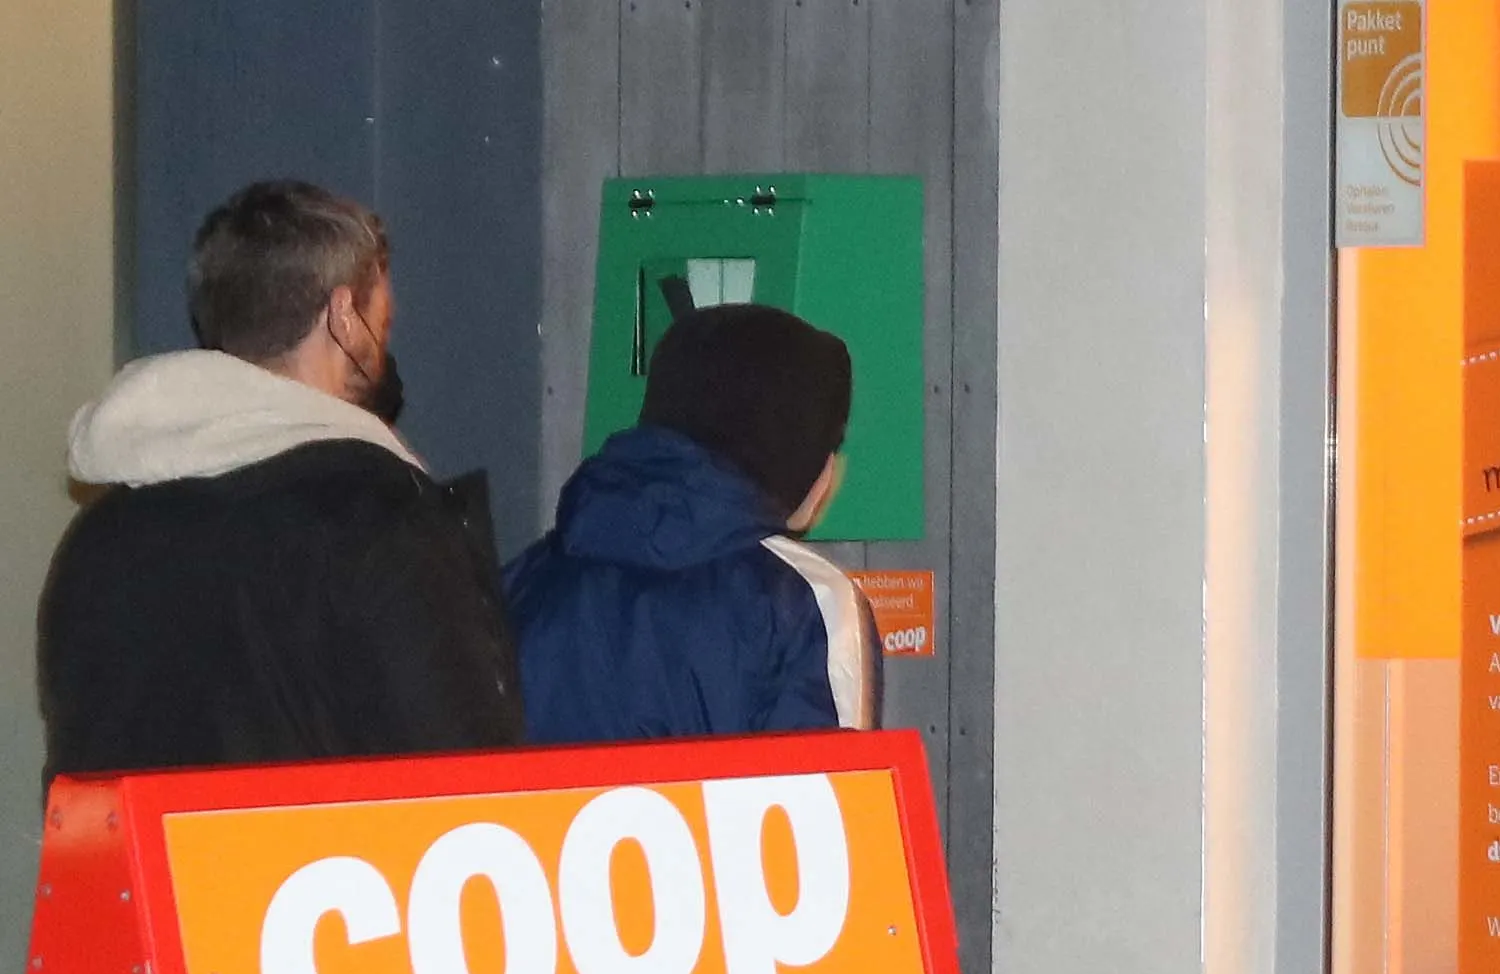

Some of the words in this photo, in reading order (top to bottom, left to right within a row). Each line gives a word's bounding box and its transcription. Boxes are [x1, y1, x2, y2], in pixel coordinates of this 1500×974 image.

[1346, 9, 1402, 32] Pakket
[1346, 36, 1385, 61] punt
[884, 626, 927, 653] coop
